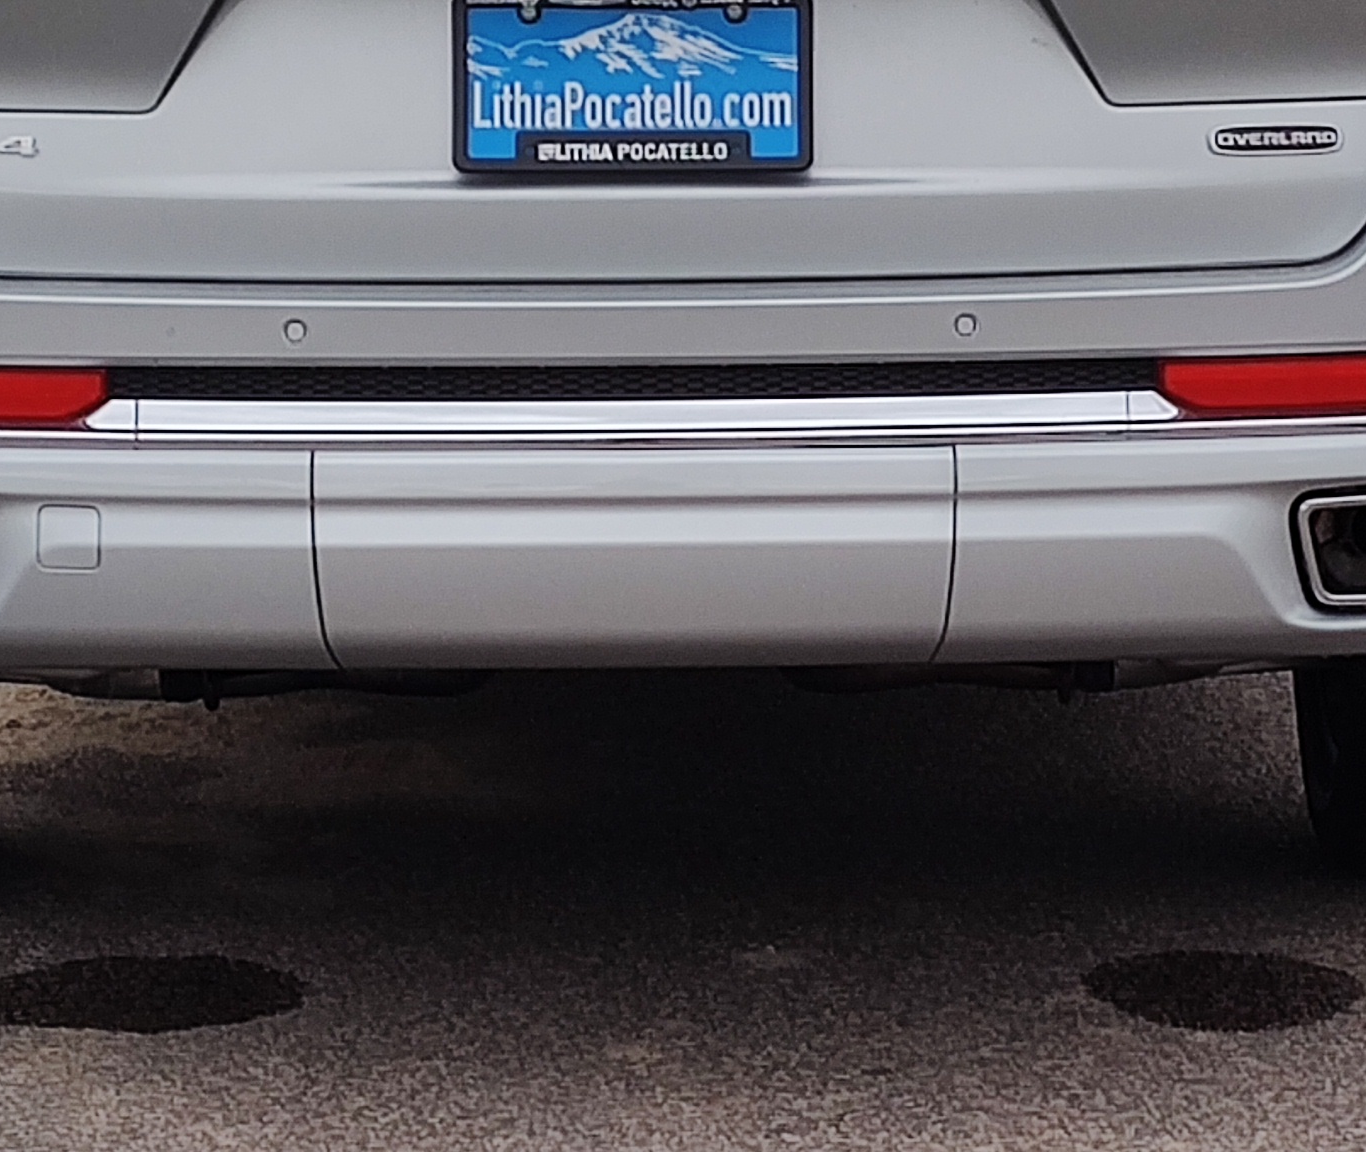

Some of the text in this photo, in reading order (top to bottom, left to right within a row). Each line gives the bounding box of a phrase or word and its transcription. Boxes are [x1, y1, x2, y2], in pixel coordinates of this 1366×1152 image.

[472, 80, 793, 129] LithiaPocatello.com
[1217, 131, 1337, 146] OVERLAND
[556, 142, 728, 161] LITHIA POCATELLO
